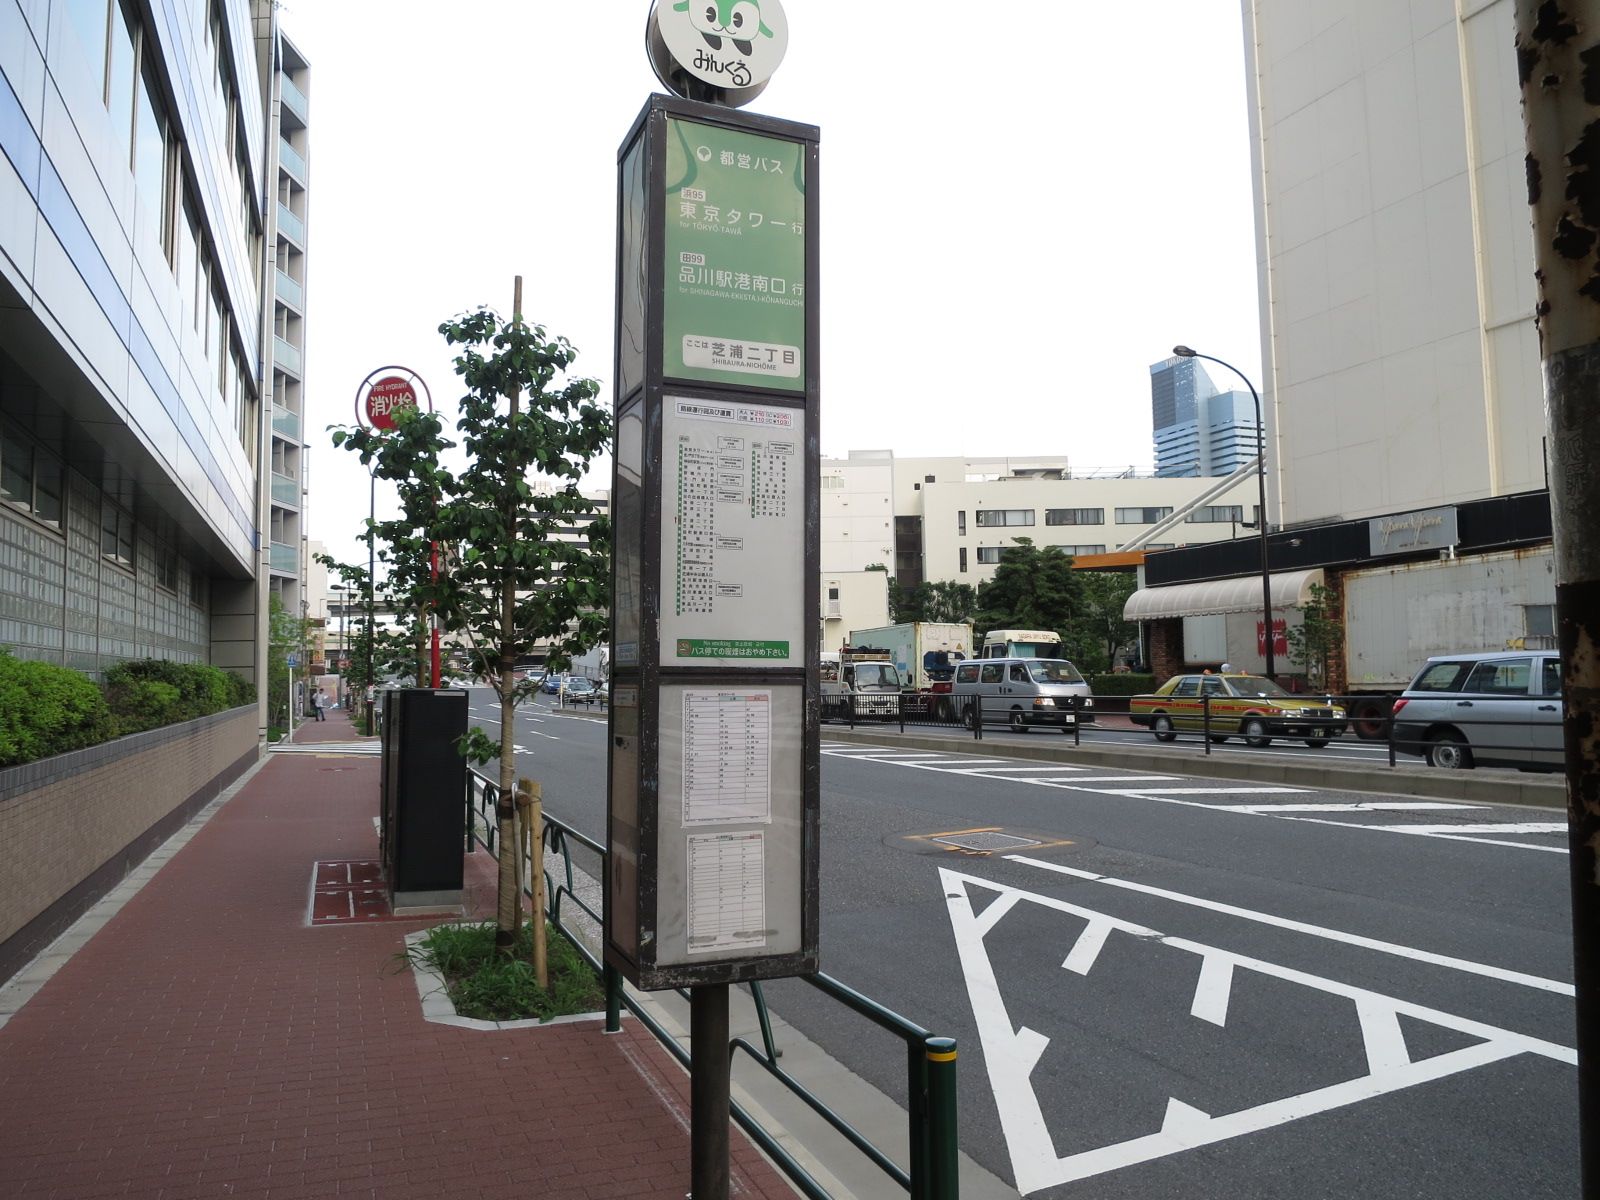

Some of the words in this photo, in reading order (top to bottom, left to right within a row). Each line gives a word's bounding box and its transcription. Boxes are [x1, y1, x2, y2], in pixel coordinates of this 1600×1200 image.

[693, 49, 752, 86] みんくる
[719, 150, 784, 174] 都営バス
[682, 253, 703, 263] 田99
[686, 339, 709, 349] ここは
[711, 342, 795, 365] 芝浦二丁目
[386, 382, 407, 391] HYDRANT
